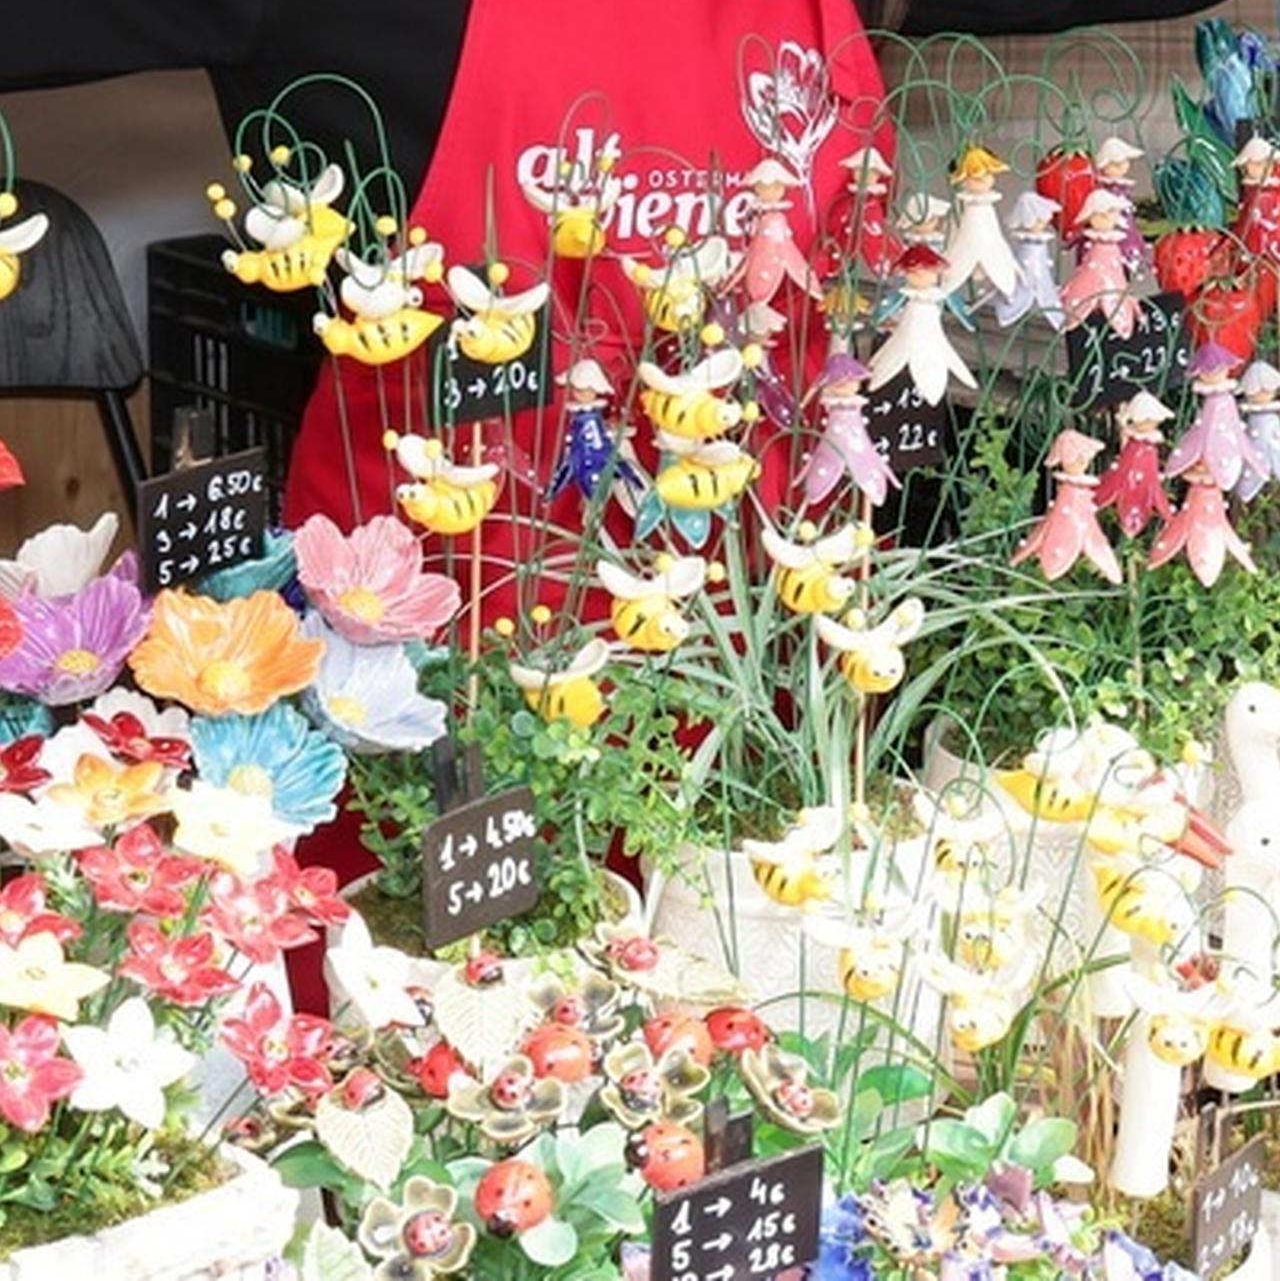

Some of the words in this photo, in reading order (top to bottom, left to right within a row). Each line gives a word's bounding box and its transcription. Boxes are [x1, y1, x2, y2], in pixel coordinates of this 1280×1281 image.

[517, 128, 623, 192] alt
[492, 361, 539, 393] 20€
[153, 493, 170, 520] 1
[157, 529, 171, 553] 3
[203, 509, 246, 535] 18€
[158, 561, 173, 586] 5
[206, 537, 252, 564] 25€
[439, 833, 456, 873] 1
[448, 881, 464, 916] 5
[487, 857, 533, 902] 20€
[670, 1199, 693, 1235] 1
[671, 1239, 693, 1271] 5
[746, 1211, 797, 1243] 15€
[747, 1242, 797, 1273] 28€
